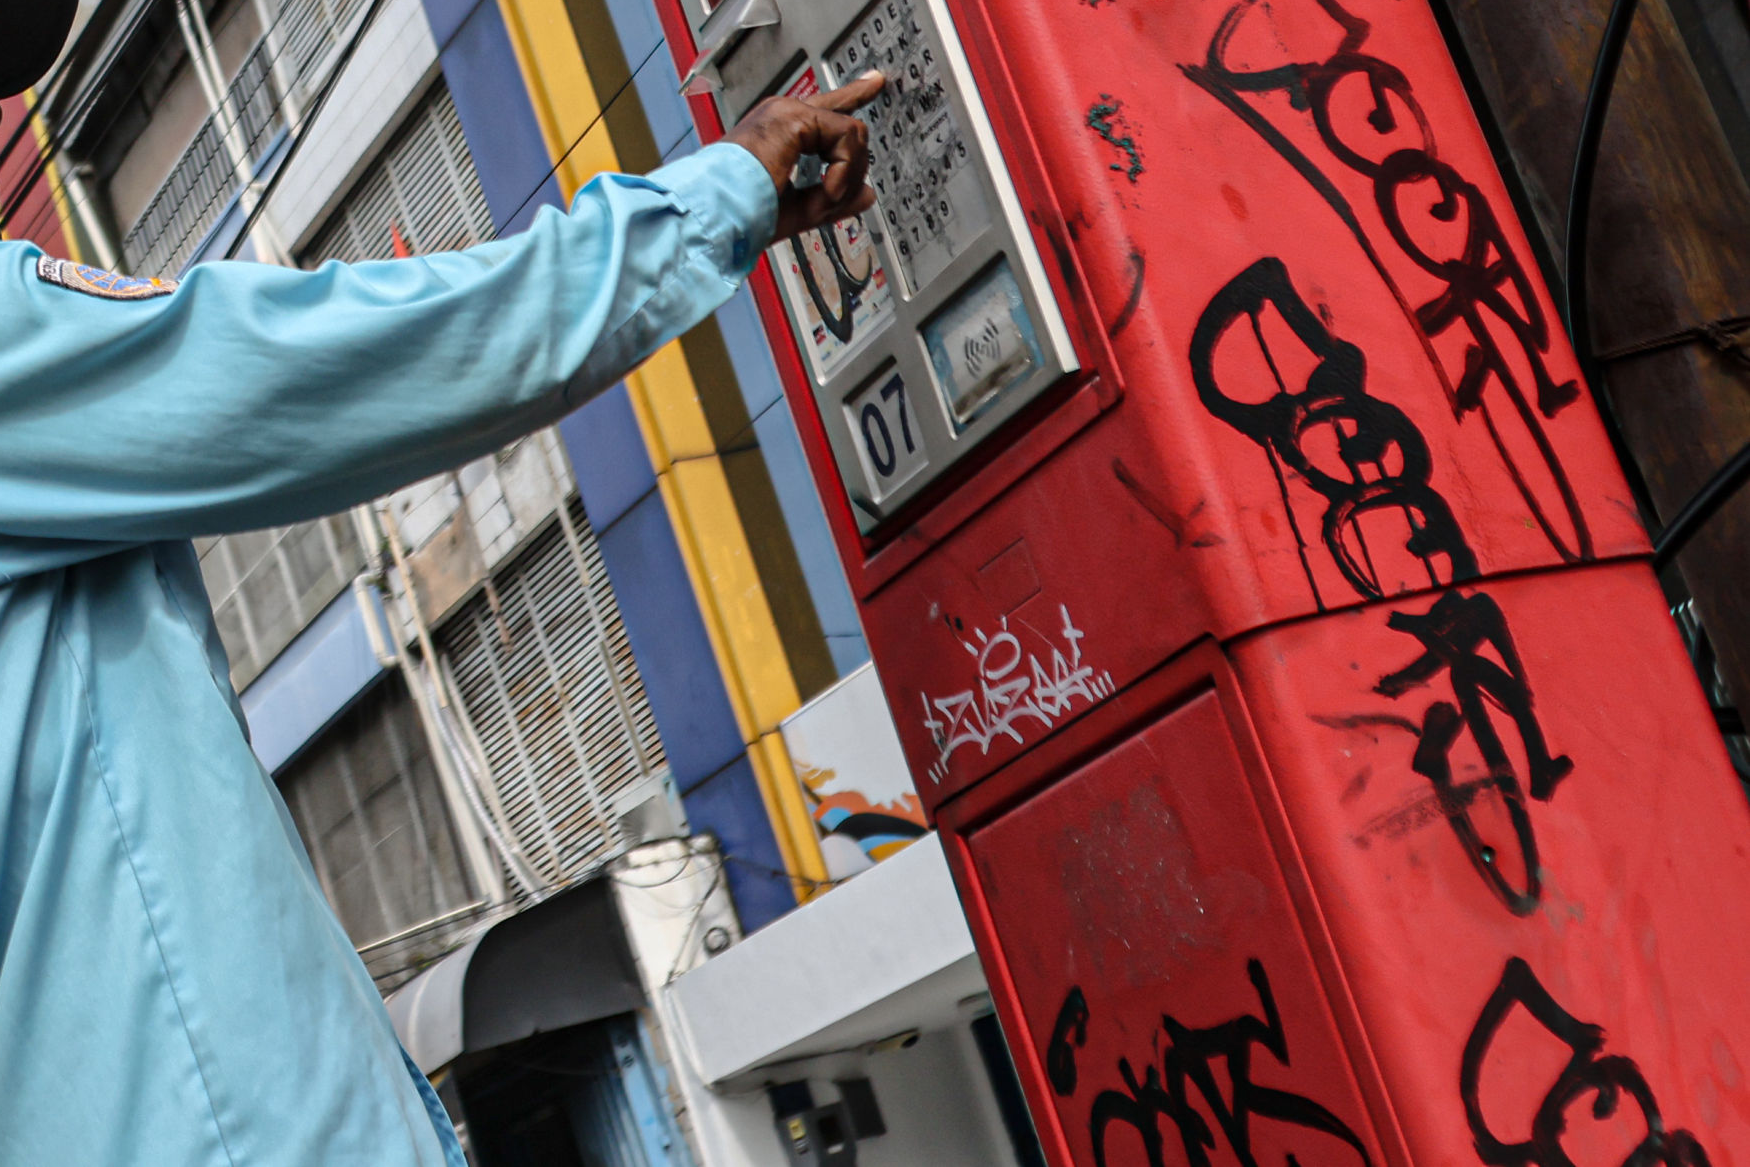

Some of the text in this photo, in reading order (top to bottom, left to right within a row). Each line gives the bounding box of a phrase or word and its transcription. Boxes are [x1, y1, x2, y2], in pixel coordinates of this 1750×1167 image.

[835, 61, 846, 78] A
[848, 47, 858, 63] B
[861, 33, 871, 48] C
[873, 18, 884, 35] D
[887, 3, 897, 20] E
[887, 20, 922, 64] J K L
[868, 105, 879, 123] N
[882, 91, 892, 108] O
[909, 63, 921, 80] Q
[922, 48, 934, 66] R
[879, 134, 889, 152] T
[905, 107, 916, 124] V
[933, 78, 945, 95] X
[876, 165, 900, 195] Y Z
[888, 140, 967, 226] 0 1 2 3 4 5
[899, 200, 949, 256] 6 7 8 9
[860, 372, 916, 478] 07
